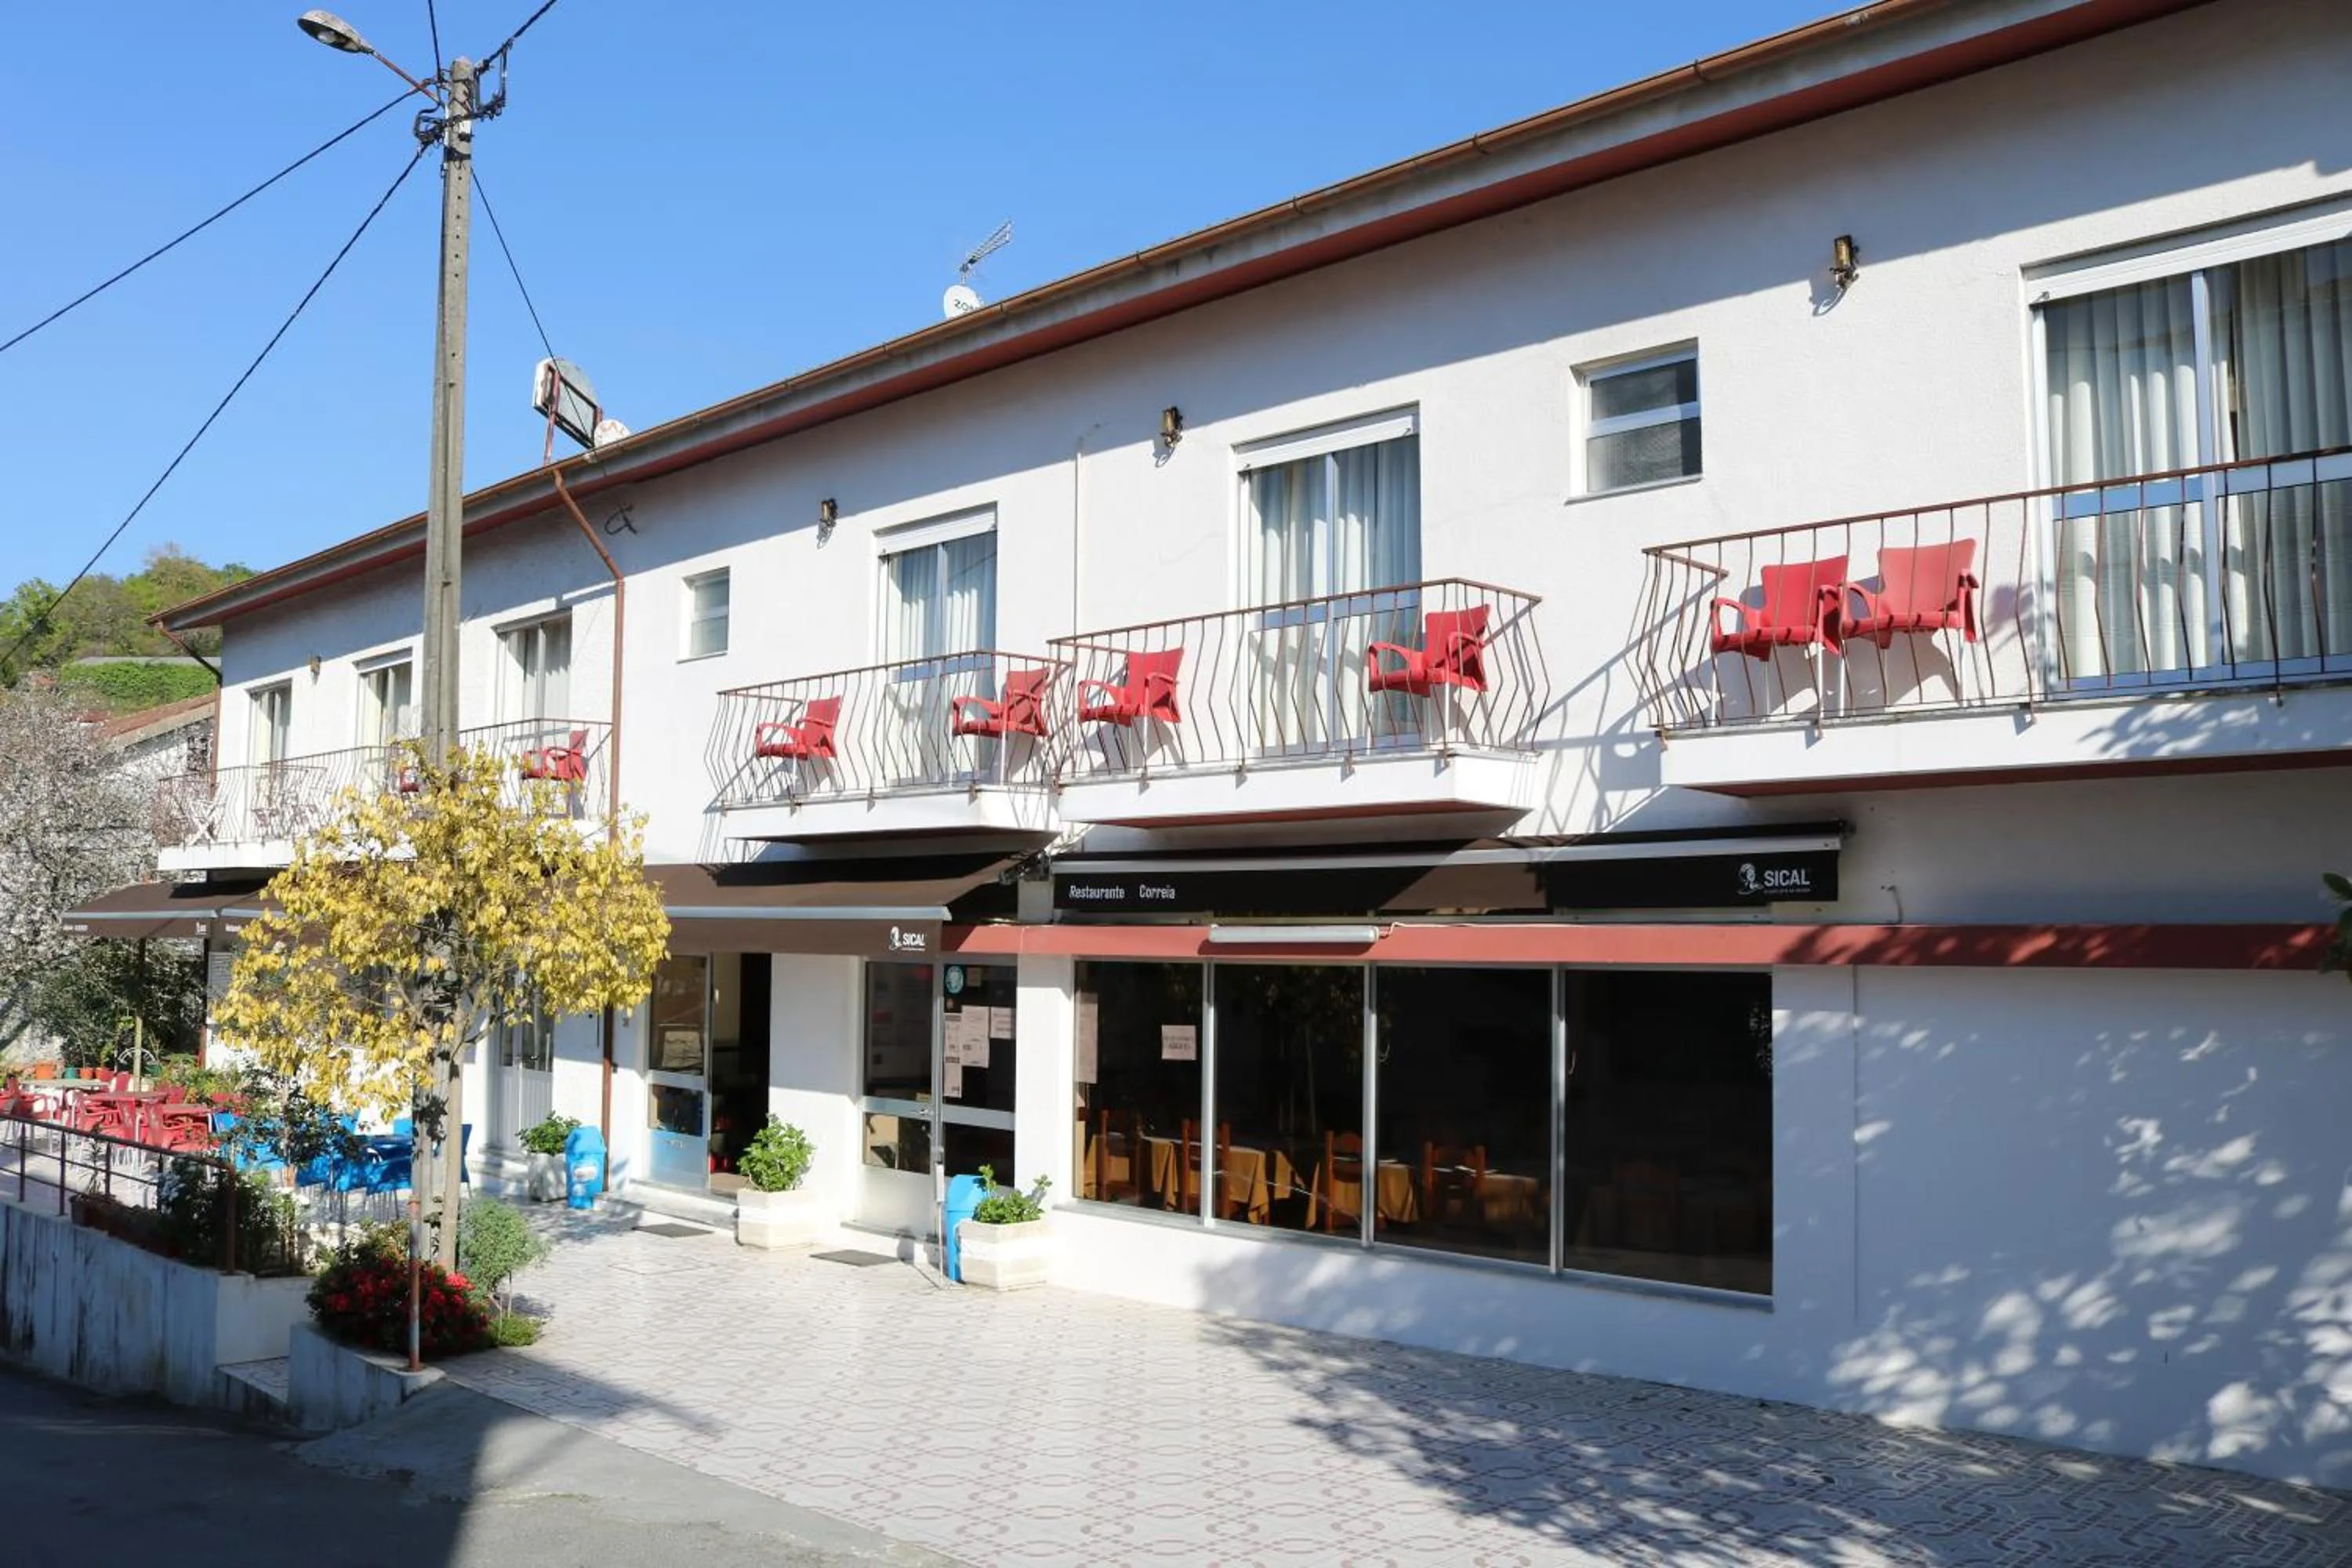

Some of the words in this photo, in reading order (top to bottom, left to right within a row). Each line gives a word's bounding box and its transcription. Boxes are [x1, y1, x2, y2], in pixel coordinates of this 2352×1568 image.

[1764, 869, 1809, 887] SICAL
[1069, 885, 1125, 899] Restaurante
[1139, 884, 1175, 899] Correia
[902, 933, 925, 946] SICAL
